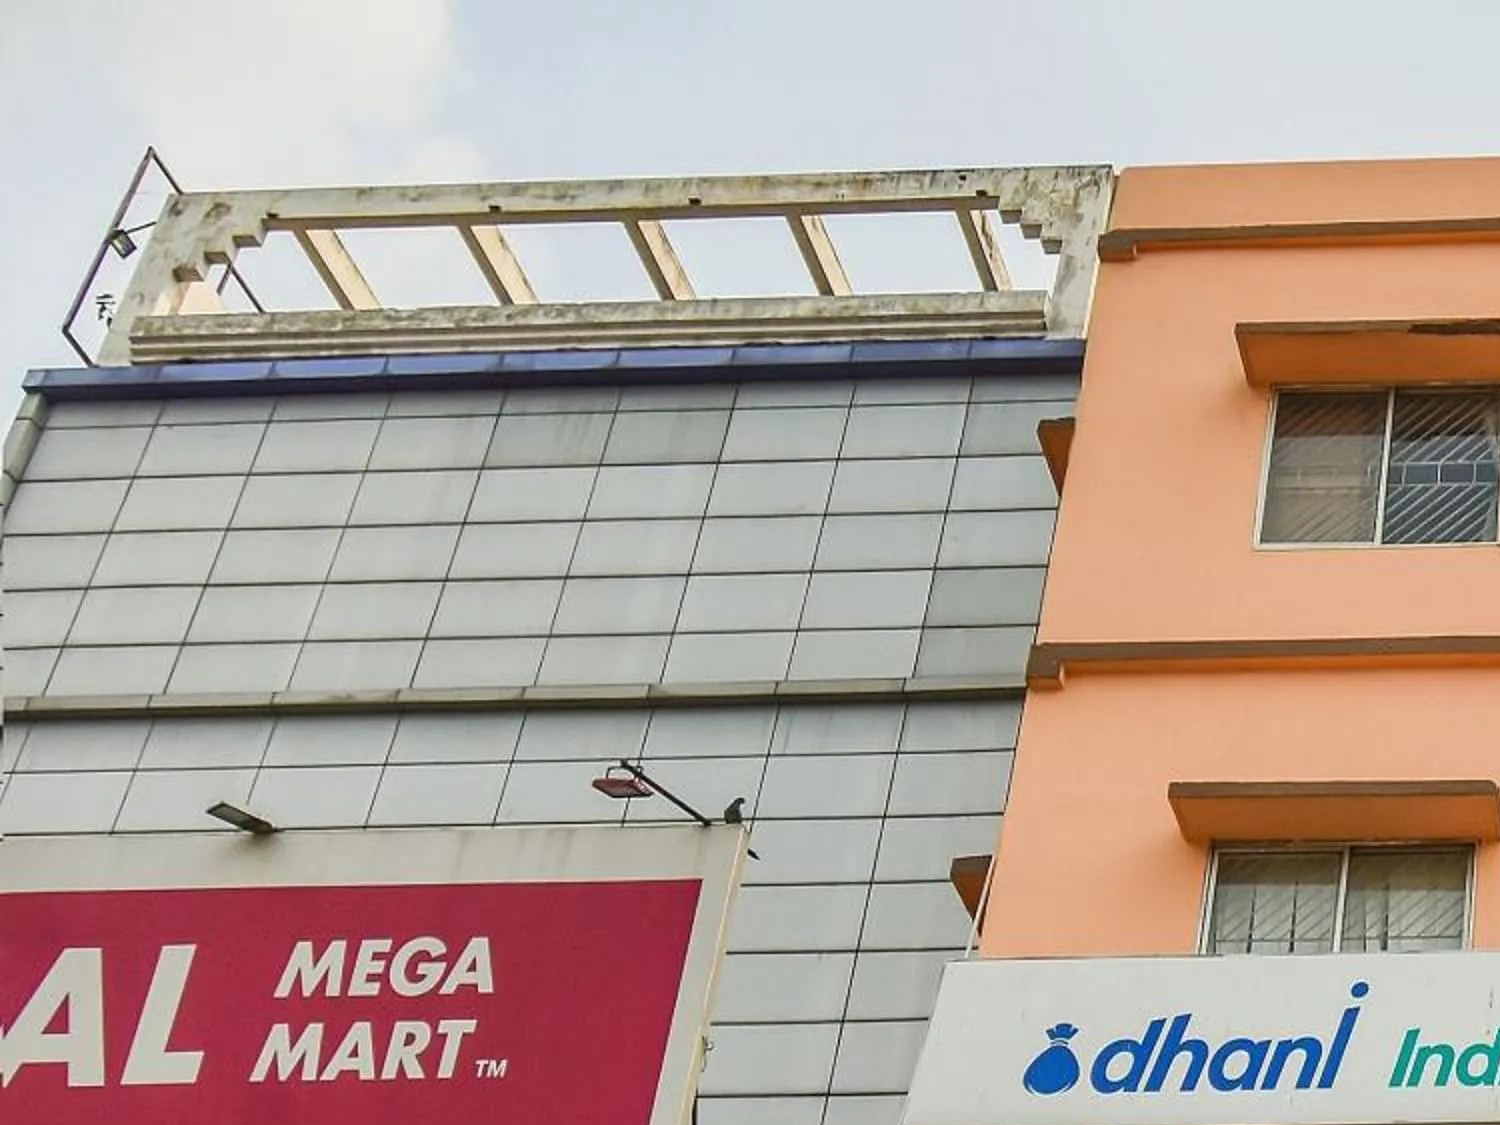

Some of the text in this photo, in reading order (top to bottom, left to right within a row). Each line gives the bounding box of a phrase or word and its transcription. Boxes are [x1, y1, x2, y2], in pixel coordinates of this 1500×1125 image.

[273, 936, 494, 999] MEGA
[249, 1019, 508, 1082] MART TM
[1091, 981, 1370, 1094] dhani
